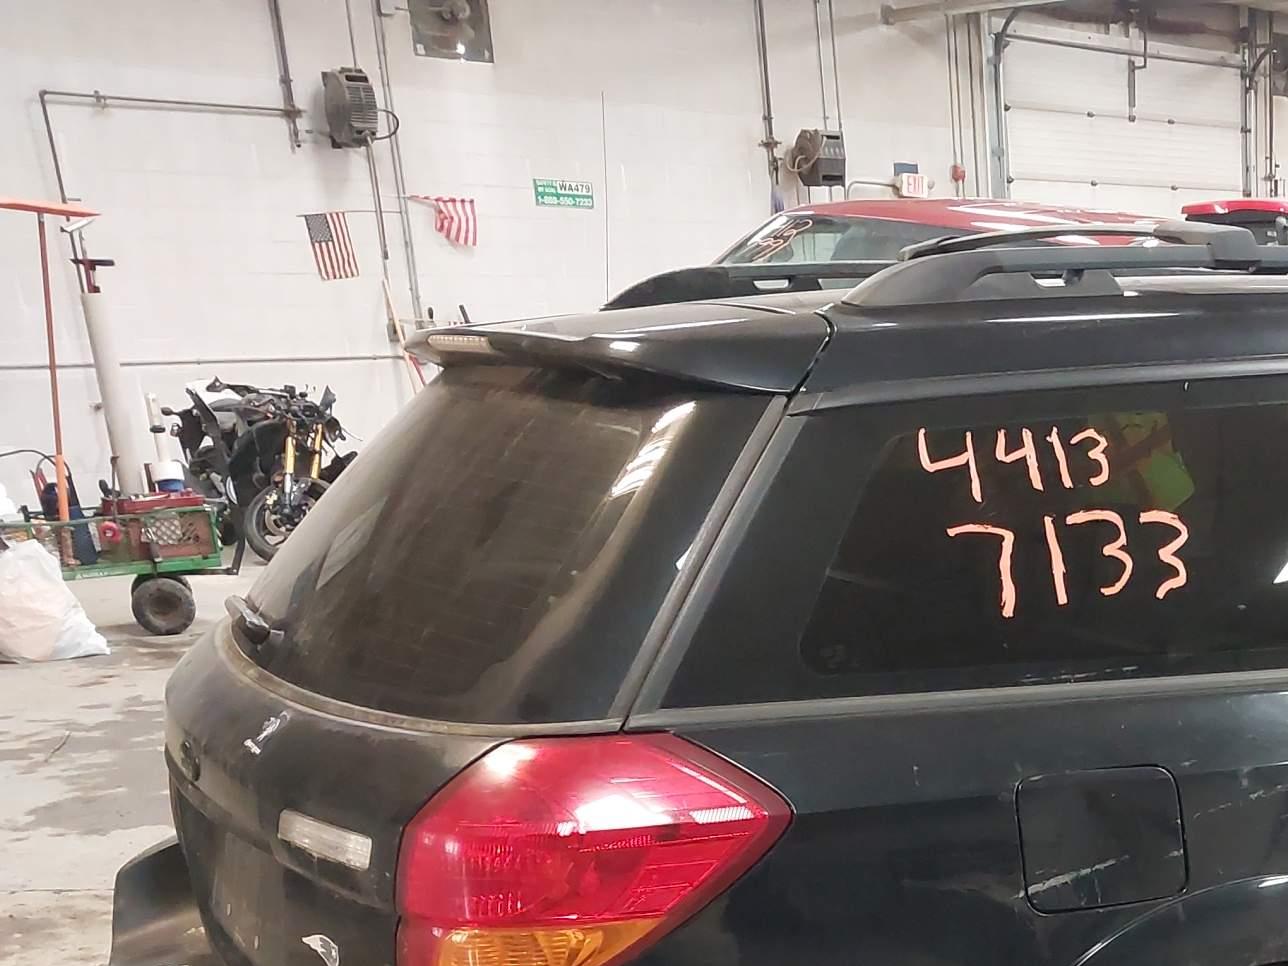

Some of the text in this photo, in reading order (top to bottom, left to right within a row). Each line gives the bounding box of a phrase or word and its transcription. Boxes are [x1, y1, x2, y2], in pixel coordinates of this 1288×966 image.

[558, 182, 591, 194] WA479
[918, 426, 1110, 503] 4413
[946, 510, 1189, 618] 7133
